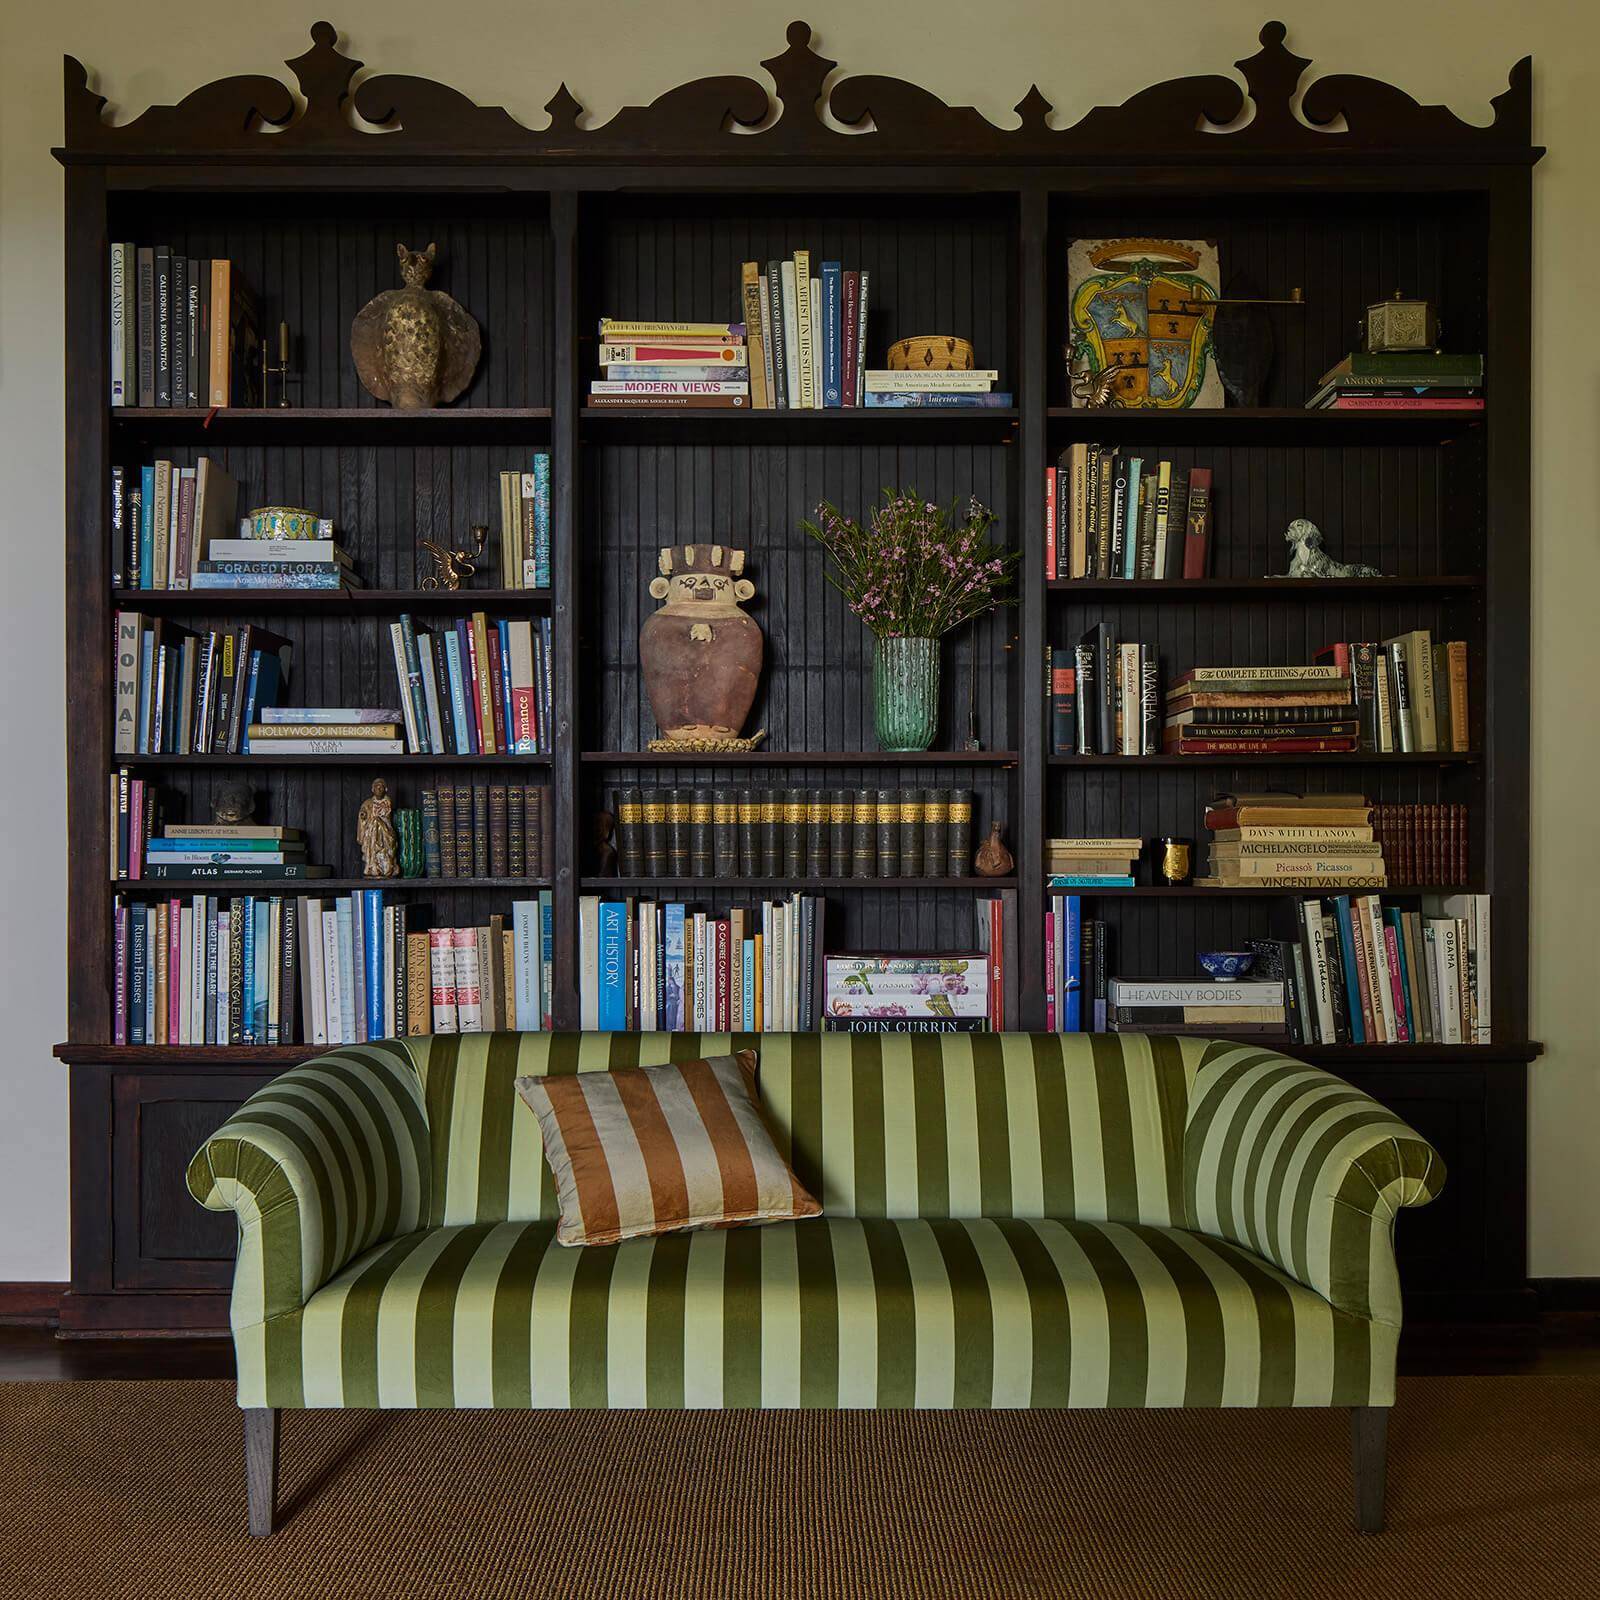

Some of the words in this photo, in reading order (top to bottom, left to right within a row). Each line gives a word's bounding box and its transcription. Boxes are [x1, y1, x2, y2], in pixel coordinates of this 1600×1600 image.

[141, 264, 152, 302] SALGADO
[798, 260, 806, 282] THE
[113, 250, 122, 326] CAROLANDS
[159, 275, 167, 322] CALIFORNIA
[774, 310, 780, 320] OF
[799, 285, 808, 320] ARTIST
[801, 324, 809, 335] IN
[160, 324, 168, 371] ROMANTICA
[802, 338, 810, 356] HIS
[142, 349, 152, 392] APERTURE
[175, 332, 183, 395] REVELATIONS
[625, 383, 678, 392] MODERN
[682, 383, 720, 392] VIEWS
[803, 358, 811, 398] STUDIO
[1344, 376, 1384, 385] ANGKOR
[158, 464, 166, 491] Marilyn
[113, 480, 122, 508] English
[1101, 484, 1110, 500] EYE
[113, 509, 123, 529] Style
[158, 496, 166, 526] Norman
[1088, 505, 1096, 532] Feeling
[1101, 501, 1109, 512] ON
[1101, 514, 1109, 529] THE
[157, 528, 165, 552] Mailer
[1100, 531, 1108, 558] WORLD
[217, 564, 276, 574] FORAGED
[224, 637, 232, 675] PLAYGROUND
[1421, 639, 1430, 680] AMERICAN
[1200, 670, 1215, 679] The
[1216, 670, 1257, 679] COMPLETE
[1260, 668, 1298, 678] ETCHINGS
[1299, 669, 1307, 680] of
[1307, 668, 1330, 677] GOYA
[197, 672, 208, 706] SCOTS
[1140, 669, 1157, 722] MARTHA
[258, 727, 325, 736] HOLLYWOOD
[327, 727, 377, 736] INTERIORS
[519, 696, 530, 750] Romance
[1241, 844, 1327, 854] MICHELANGELO
[1276, 862, 1312, 872] Picasso's
[1316, 862, 1353, 872] Picassos
[1261, 878, 1312, 887] VINCENT
[1317, 878, 1341, 887] VAN
[1348, 877, 1385, 887] GOGH
[606, 909, 618, 933] ART
[134, 924, 144, 963] Russian
[210, 944, 216, 953] IN
[232, 936, 241, 966] YEARS
[416, 937, 426, 967] JOHN
[732, 939, 740, 968] California
[1446, 931, 1455, 969] OBAMA
[158, 943, 166, 983] HASLAM
[245, 951, 254, 990] PARRISH
[606, 936, 618, 988] HISTORY
[734, 968, 740, 976] of
[1367, 941, 1377, 993] INTERNATIONAL
[134, 966, 143, 1003] Houses
[232, 968, 241, 989] RON
[416, 971, 425, 1016] SLOAN'S
[1128, 990, 1193, 1001] HEAVENLY
[1196, 990, 1241, 1001] BODIES
[232, 990, 241, 1029] GALELLA
[848, 1021, 889, 1032] JOHN
[896, 1021, 958, 1032] CURRIN
